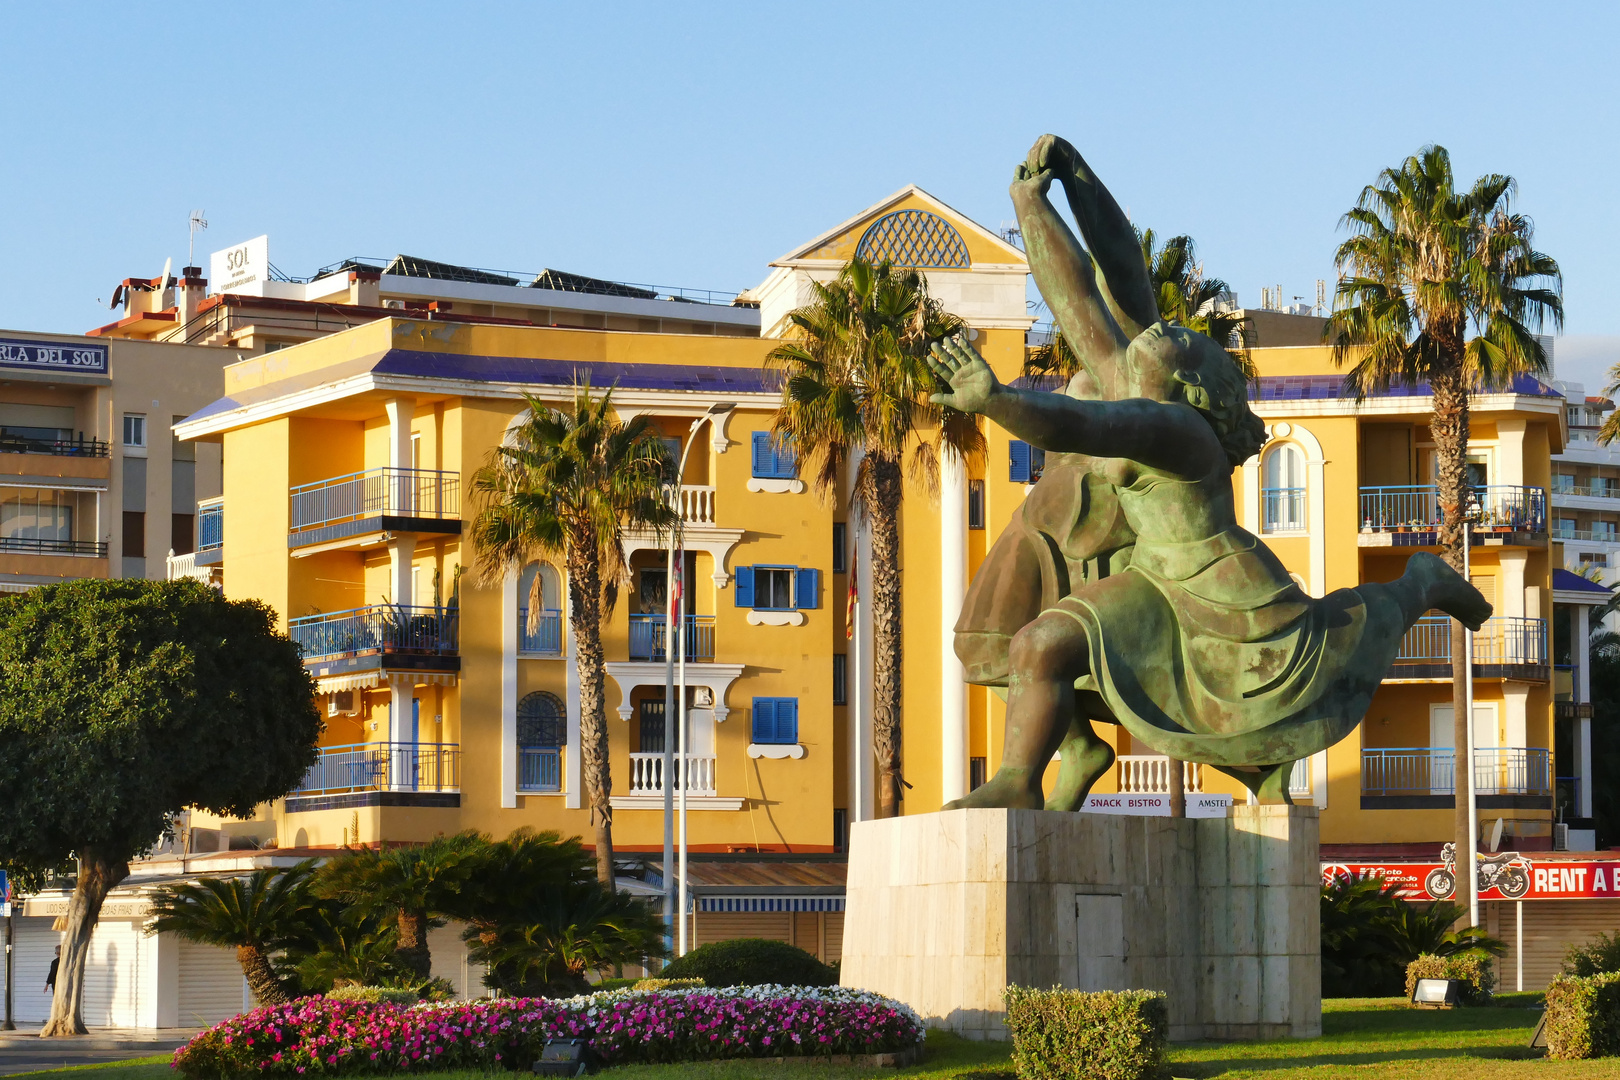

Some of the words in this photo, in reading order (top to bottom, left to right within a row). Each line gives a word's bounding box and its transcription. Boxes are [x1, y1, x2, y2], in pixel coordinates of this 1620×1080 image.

[227, 246, 250, 271] SOL
[36, 348, 67, 364] DEL
[72, 351, 100, 366] SOL
[1090, 799, 1121, 807] SNACK
[1128, 799, 1161, 807] BISTRO
[1534, 868, 1587, 892] RENT
[1592, 867, 1607, 892] A
